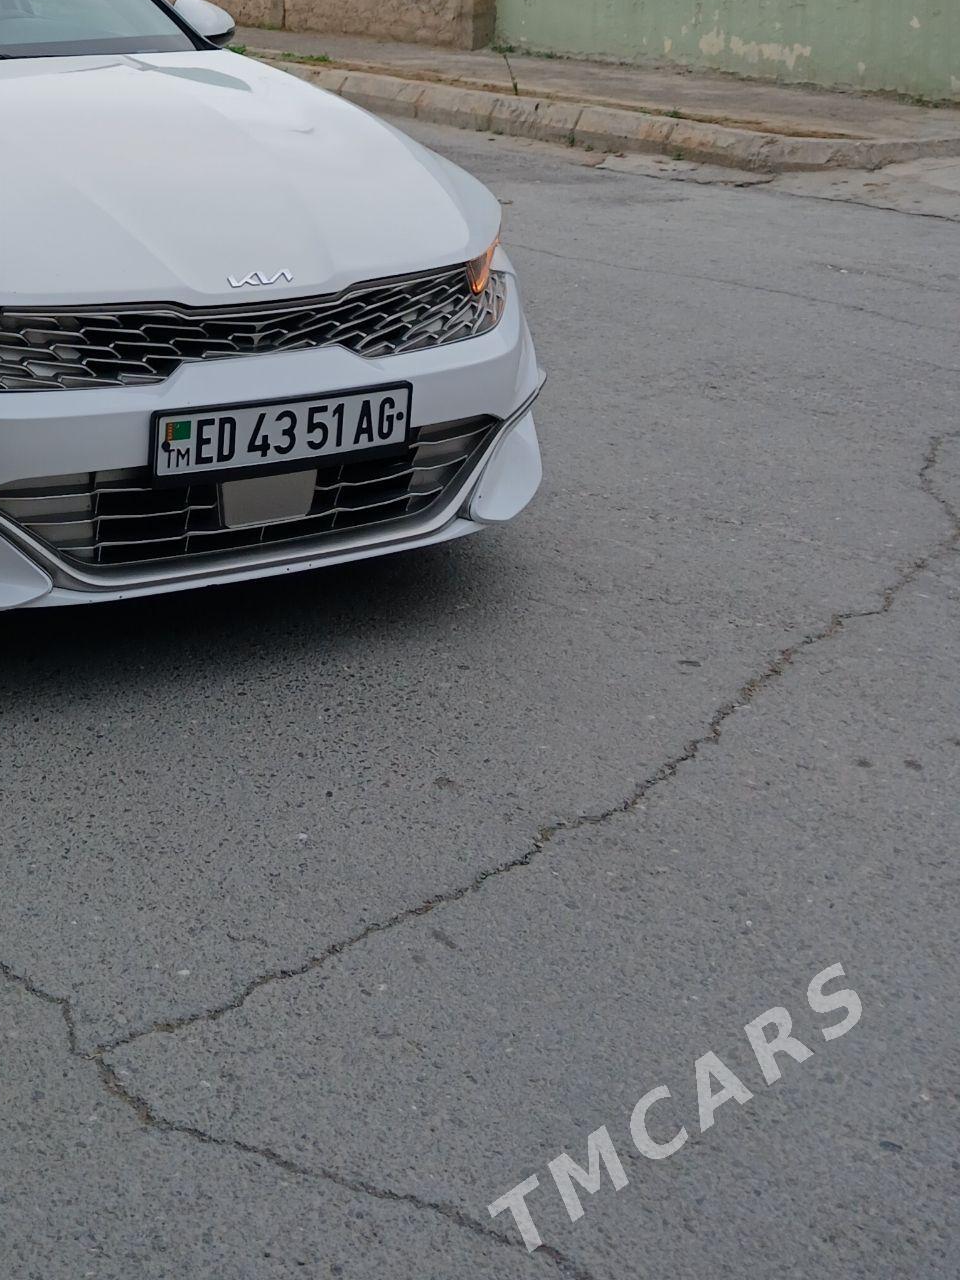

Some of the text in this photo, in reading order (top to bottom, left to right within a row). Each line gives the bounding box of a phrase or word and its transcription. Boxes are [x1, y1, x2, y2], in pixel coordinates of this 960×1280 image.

[195, 417, 237, 465] ED
[353, 396, 396, 445] AG
[164, 447, 191, 469] TM
